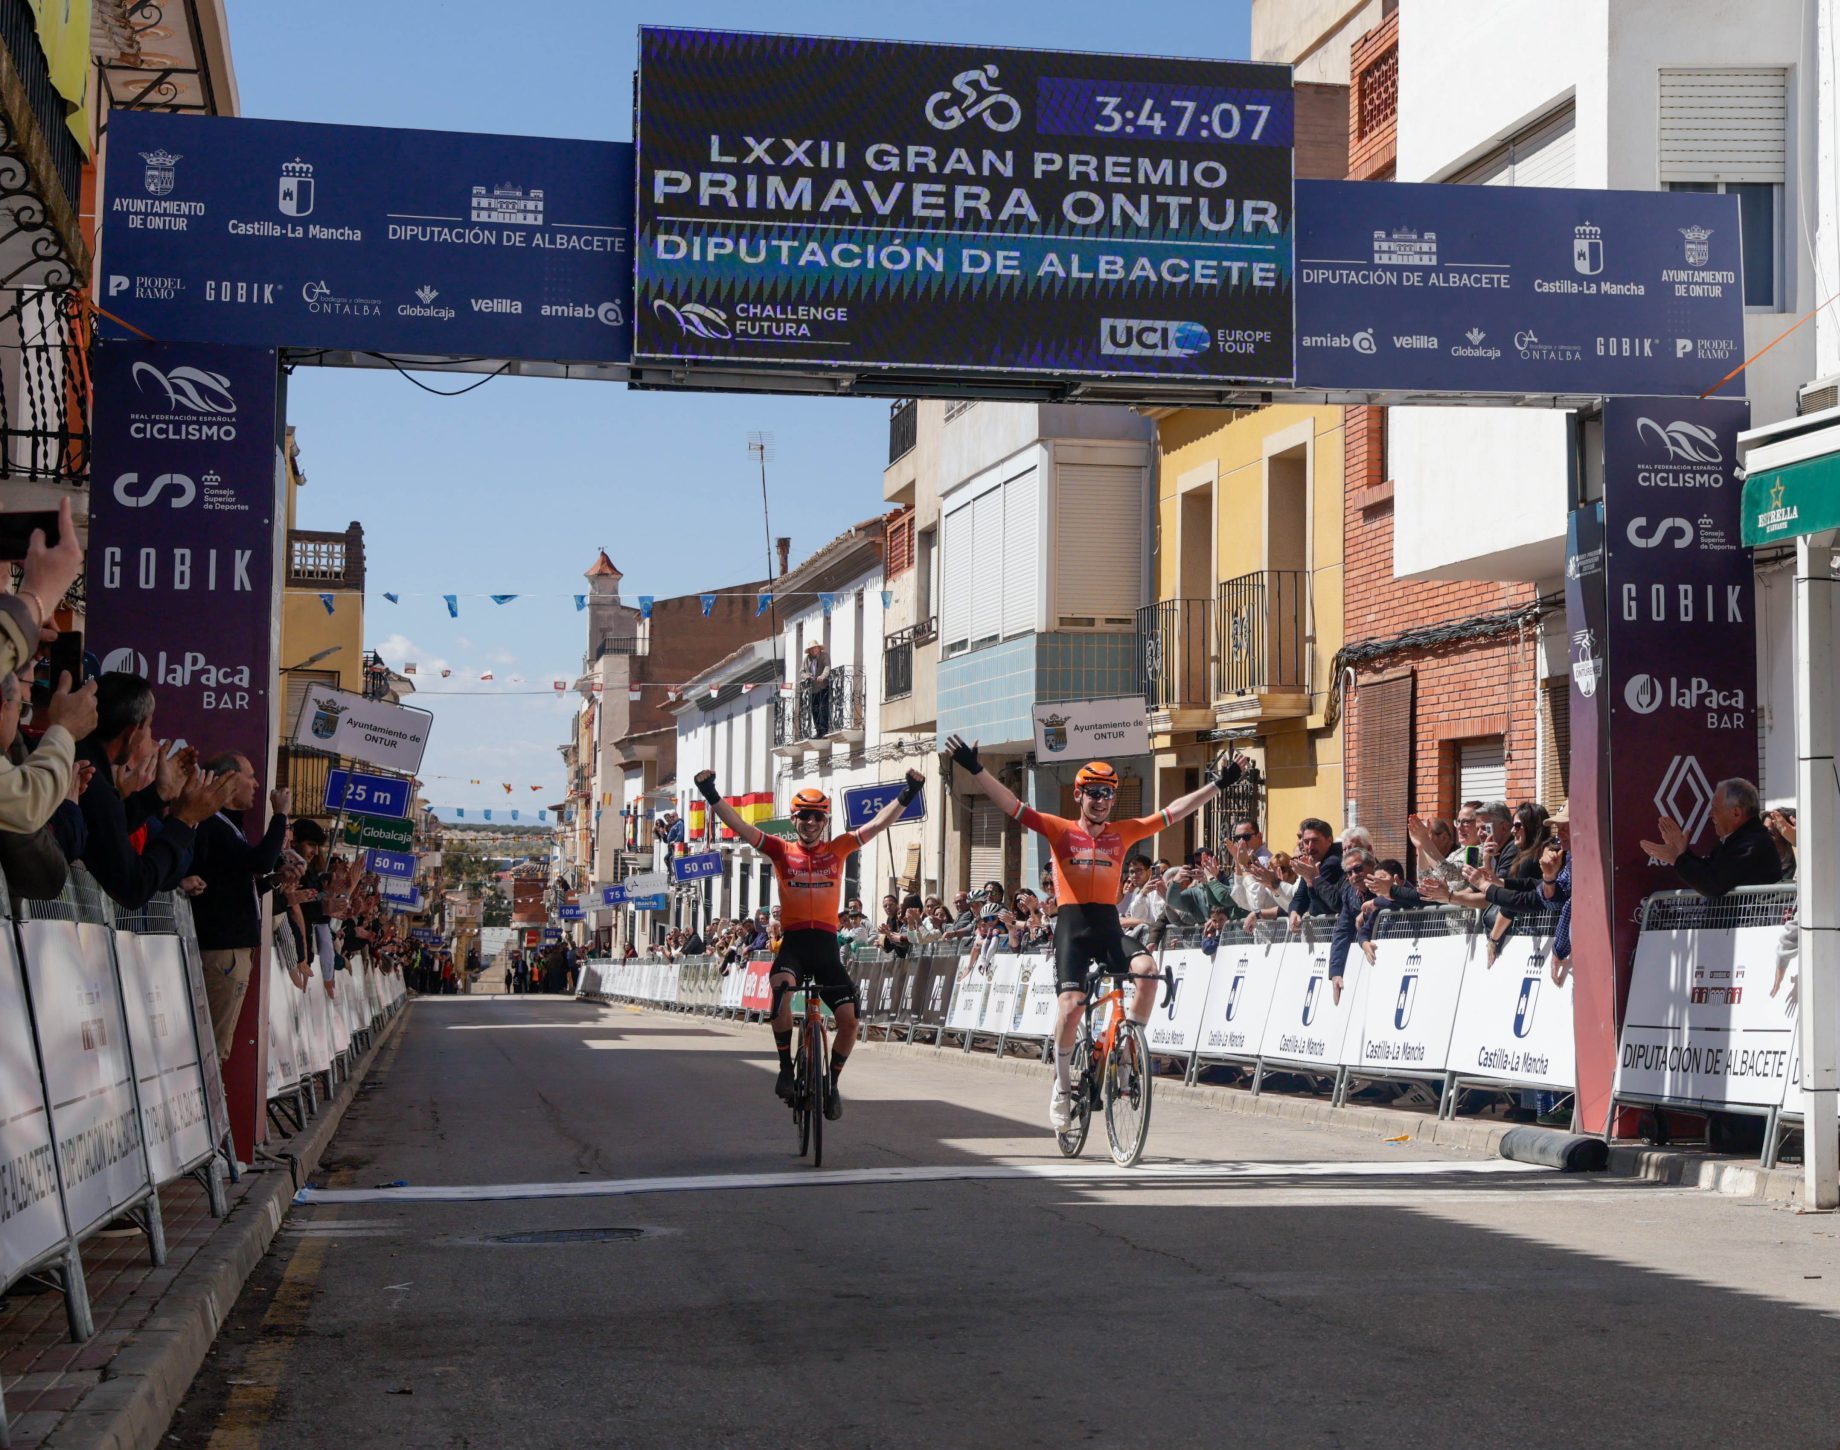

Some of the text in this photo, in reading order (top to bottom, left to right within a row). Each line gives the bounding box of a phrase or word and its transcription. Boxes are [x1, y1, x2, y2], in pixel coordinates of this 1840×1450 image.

[1094, 95, 1272, 141] 3:47:07
[711, 134, 1227, 189] LXXII GRAN PREMIO
[113, 198, 205, 216] AYUNTAMIENTO
[654, 169, 1279, 234] PRIMAVERA ONTUR
[129, 215, 187, 231] DE ONTUR
[228, 220, 362, 241] Castilla-La Mancha
[389, 224, 625, 252] DIPUTACIÓN DE ALBACETE
[656, 234, 1276, 287] DIPUTACIÓN DE ALBACETE
[1303, 268, 1510, 288] DIPUTACIÓN DE ALBACETE
[1662, 269, 1735, 284] AYUNTAMIENTO
[136, 287, 175, 300] RAMO
[206, 281, 274, 304] GOBIK
[1534, 279, 1645, 296] Castilla-La Mancha
[1675, 284, 1722, 298] DE ONTUR
[309, 302, 381, 316] ONTALBA
[397, 305, 455, 320] Globalcaja
[470, 298, 522, 314] velilla
[541, 303, 595, 318] amiab
[736, 303, 848, 321] CHALLENGE
[736, 320, 811, 337] FUTURA
[1217, 329, 1271, 343] EUROPE
[1109, 325, 1169, 350] UCI
[1302, 333, 1350, 348] amiab
[1393, 335, 1438, 349] velilla
[1217, 341, 1255, 354] TOUR
[1451, 346, 1501, 360] Globalcaja
[1521, 350, 1582, 361] ONTALBA
[1597, 337, 1652, 357] GOBIK
[1697, 349, 1729, 360] RAMO
[130, 423, 236, 441] CICLISMO
[1638, 472, 1723, 488] CICLISMO
[204, 487, 234, 497] Consejo
[204, 495, 236, 504] Superior
[215, 503, 249, 511] Deportes
[1757, 505, 1798, 528] ESTRELLA
[1700, 530, 1724, 538] Consejo
[104, 547, 252, 591] GOBIK
[1623, 583, 1742, 623] GOBIK
[158, 652, 250, 688] laPaca
[203, 692, 249, 710] BAR
[1670, 677, 1744, 709] laPaca
[1074, 719, 1144, 733] Ayuntamiento de
[1707, 713, 1744, 729] BAR
[347, 717, 421, 743] Ayuntamiento de
[1094, 731, 1125, 741] ONTUR
[364, 733, 398, 749] ONTUR
[344, 783, 391, 805] 25 m
[861, 797, 883, 816] 25
[363, 827, 412, 844] Globalcaja
[374, 857, 405, 871] 50 m
[684, 861, 714, 873] 50 m
[609, 891, 621, 899] 75
[1280, 1034, 1325, 1056] Castilla-La Mancha
[1366, 1040, 1425, 1061] Castilla-La Mancha
[1478, 1046, 1549, 1075] Castilla-La Mancha
[1623, 1042, 1703, 1073] DIPUTACIÓN
[1704, 1049, 1723, 1075] DE
[1724, 1050, 1787, 1078] ALBACETE
